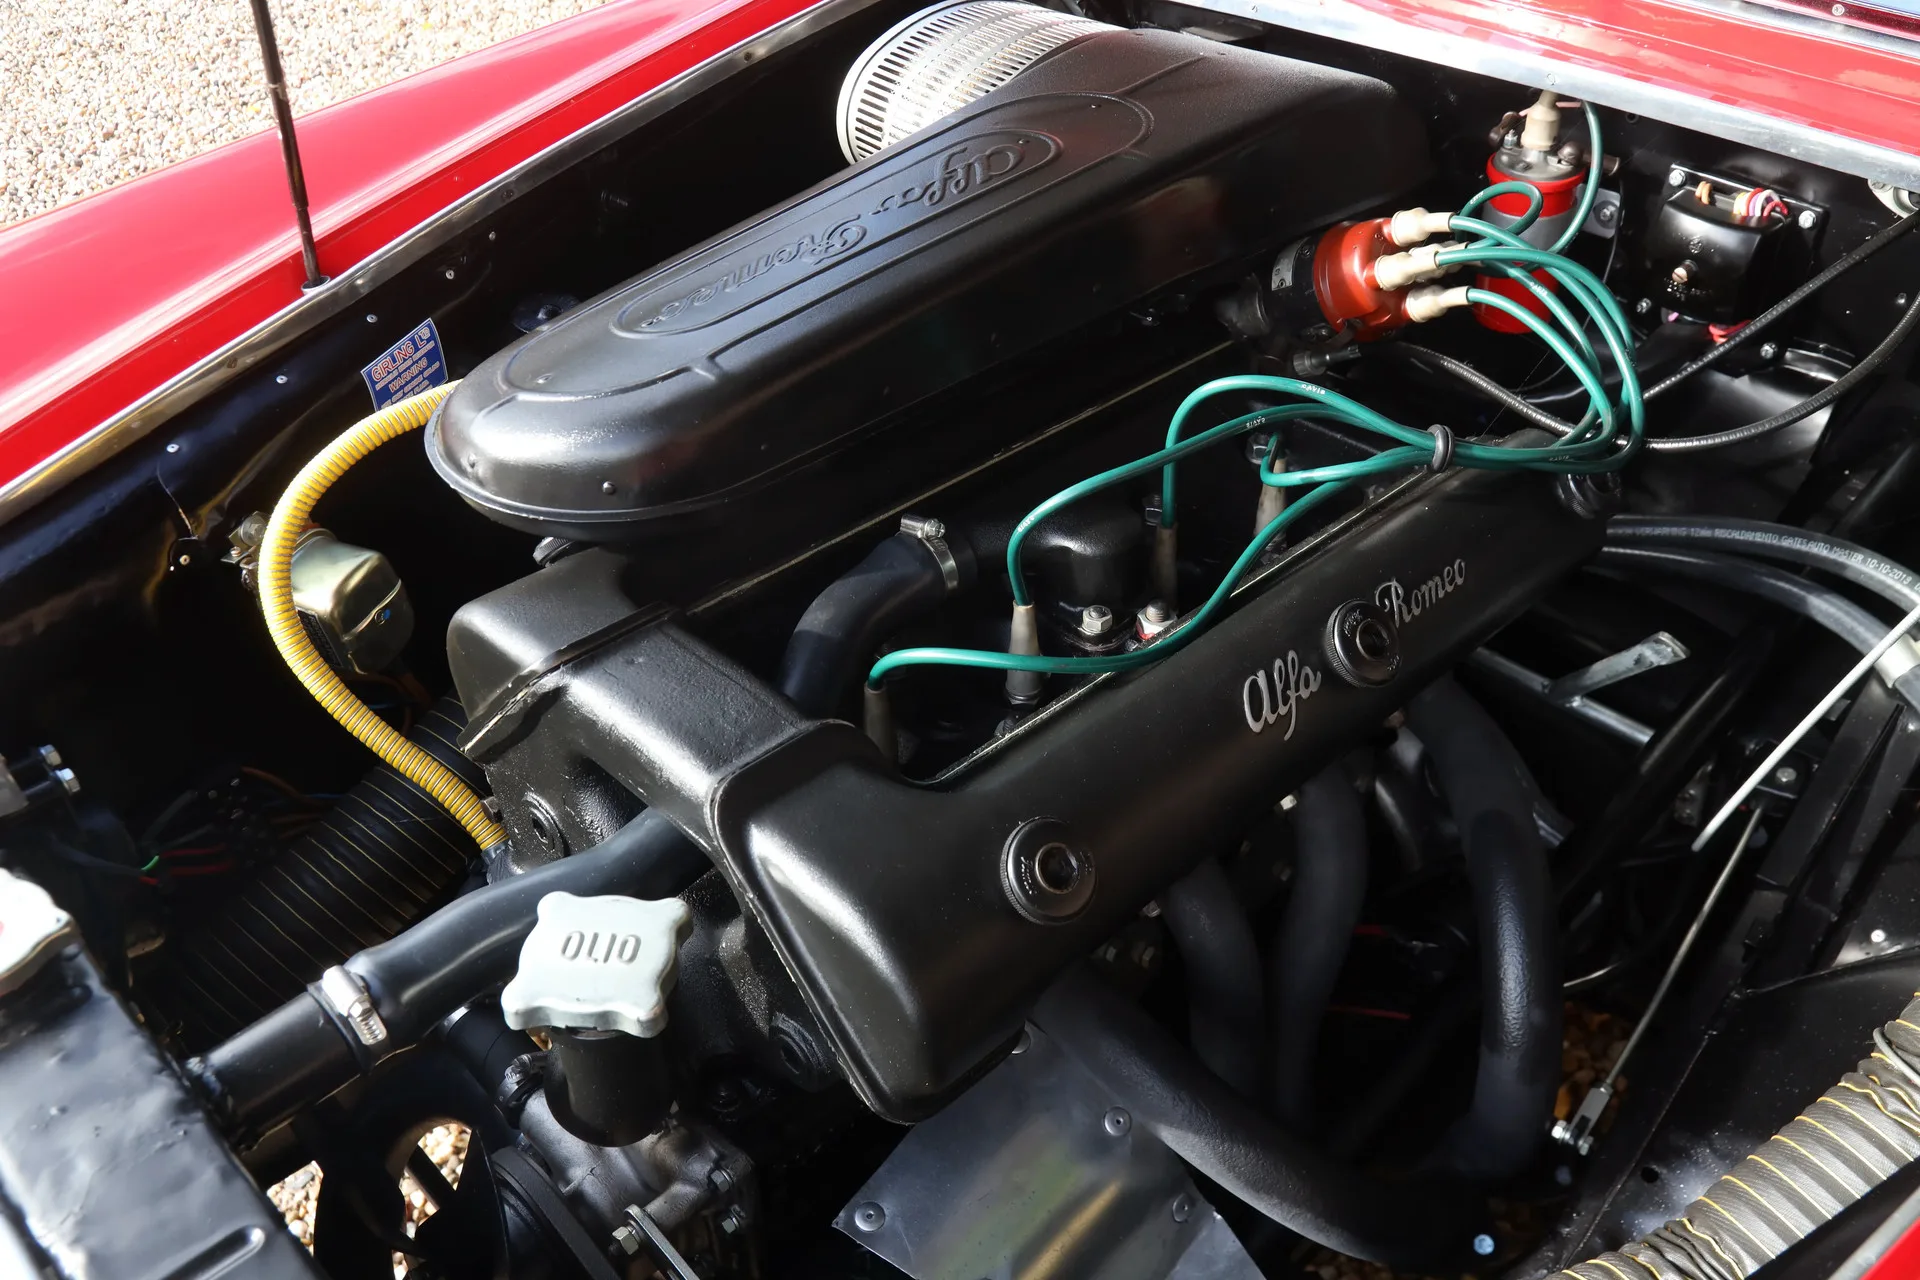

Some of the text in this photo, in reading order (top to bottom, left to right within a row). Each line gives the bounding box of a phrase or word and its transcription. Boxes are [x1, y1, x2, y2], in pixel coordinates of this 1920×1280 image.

[371, 340, 415, 382] GIRLING
[388, 357, 428, 393] WARNING
[1375, 558, 1466, 628] Romeo
[560, 930, 642, 965] OLIO
